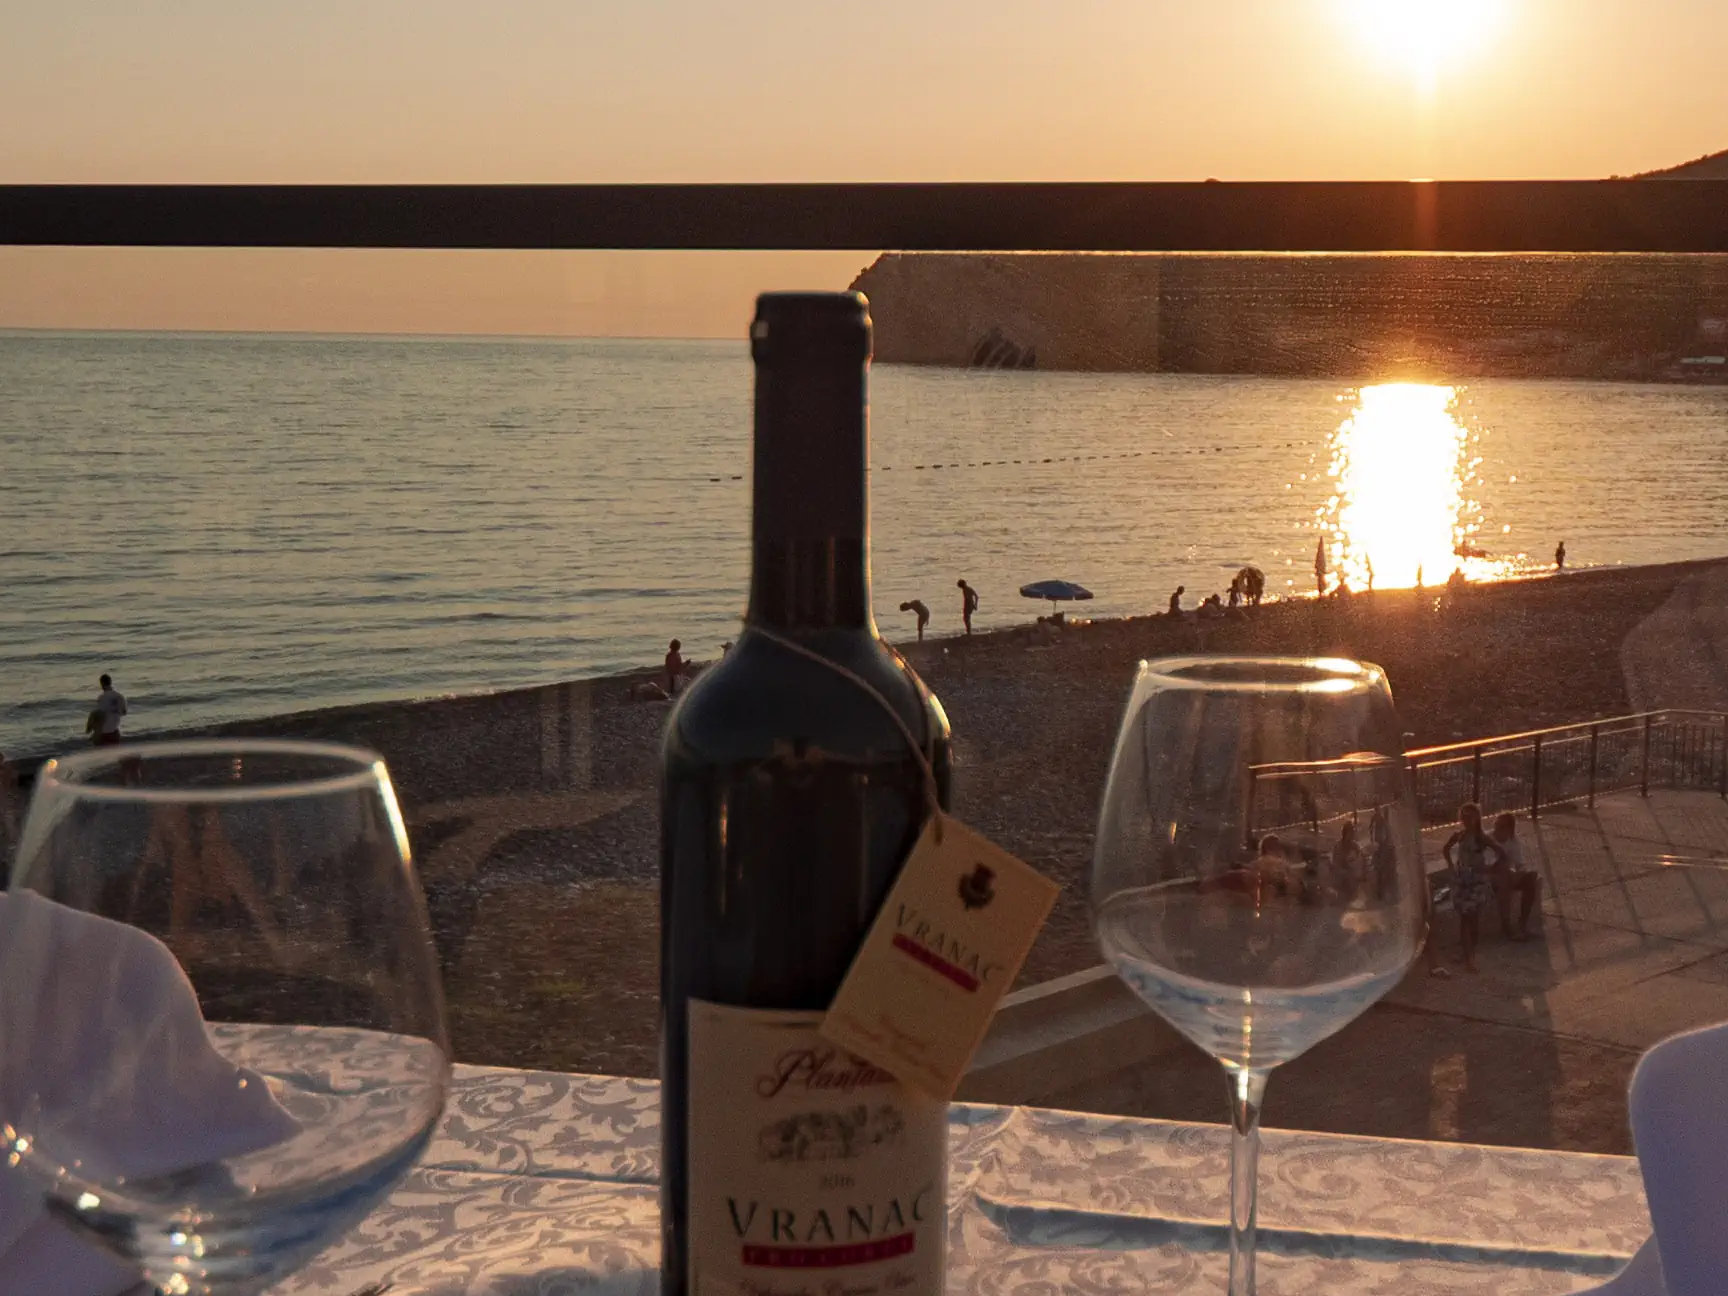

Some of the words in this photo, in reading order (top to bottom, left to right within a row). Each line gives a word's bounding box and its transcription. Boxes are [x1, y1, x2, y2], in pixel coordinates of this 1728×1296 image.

[894, 902, 1005, 982] VRANAC
[756, 1046, 897, 1100] Planta
[726, 1181, 931, 1243] VRANAC
